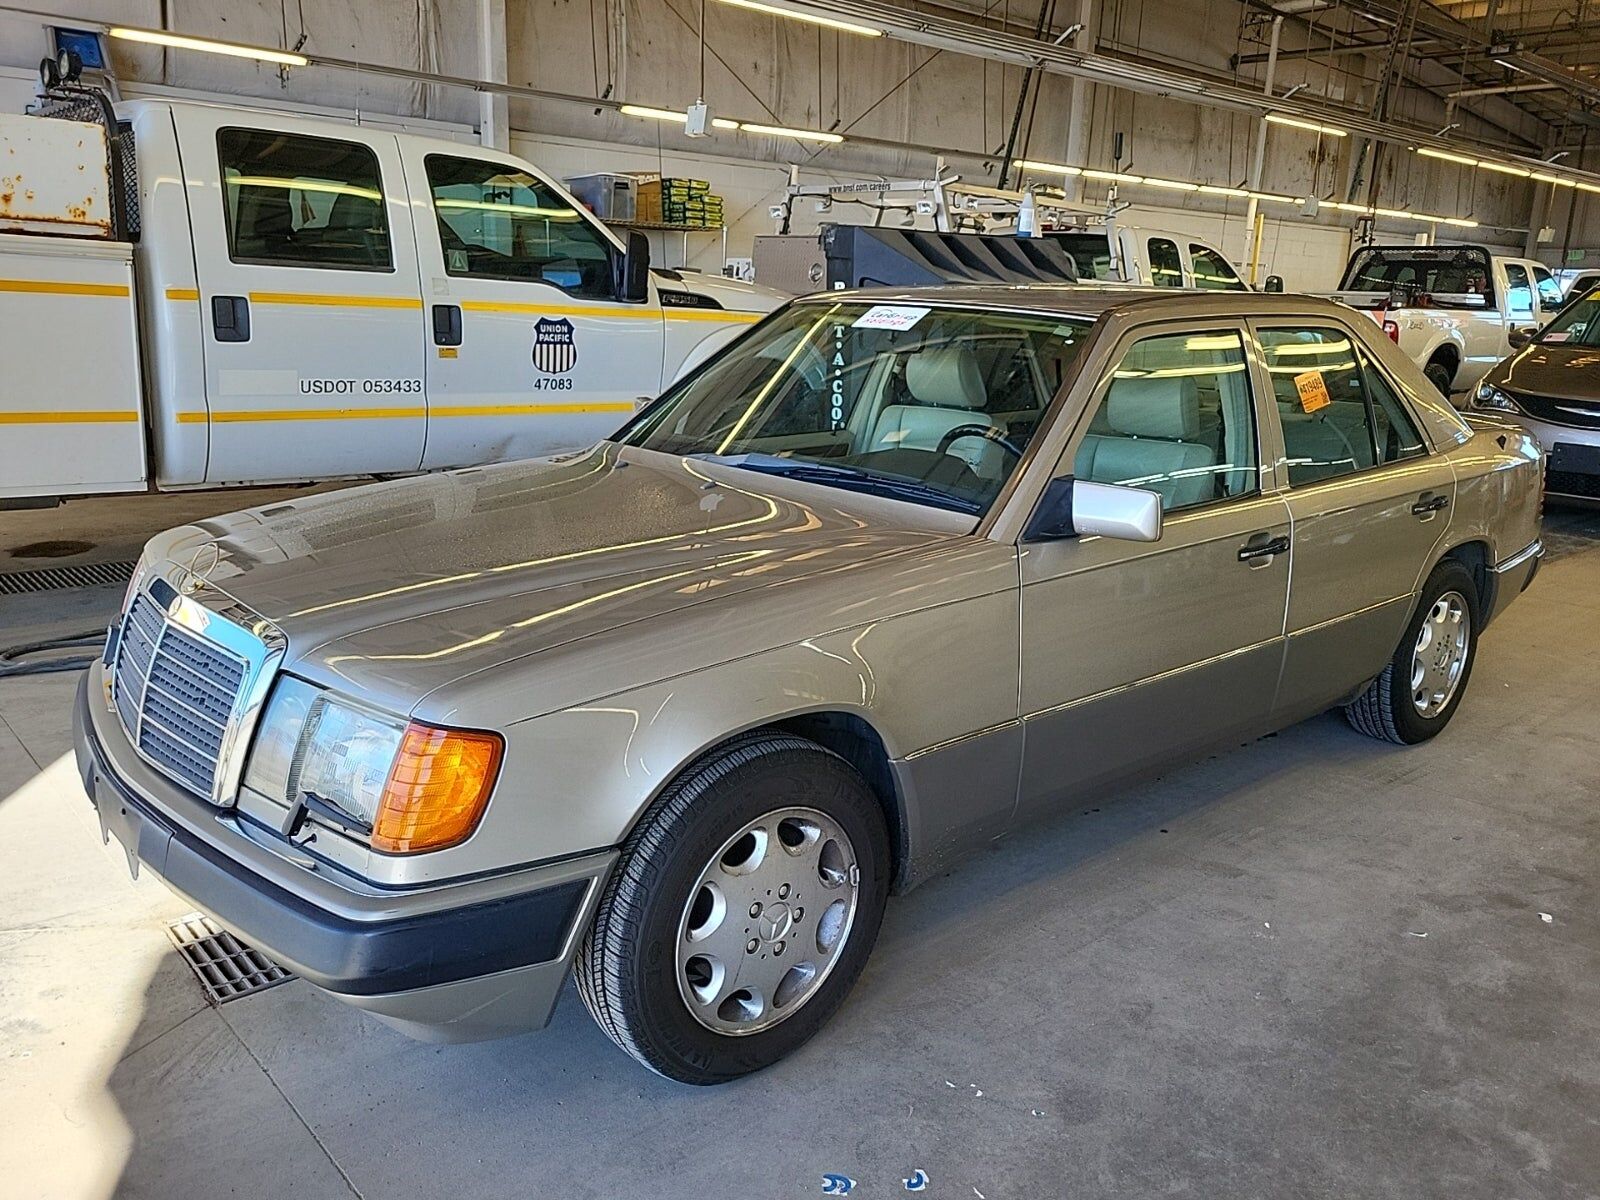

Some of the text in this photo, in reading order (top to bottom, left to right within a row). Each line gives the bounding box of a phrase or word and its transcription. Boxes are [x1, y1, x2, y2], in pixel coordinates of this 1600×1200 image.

[540, 324, 568, 333] UNION
[539, 333, 570, 342] PACIFIC
[300, 380, 422, 393] USDOT 053433
[534, 378, 573, 390] 47083
